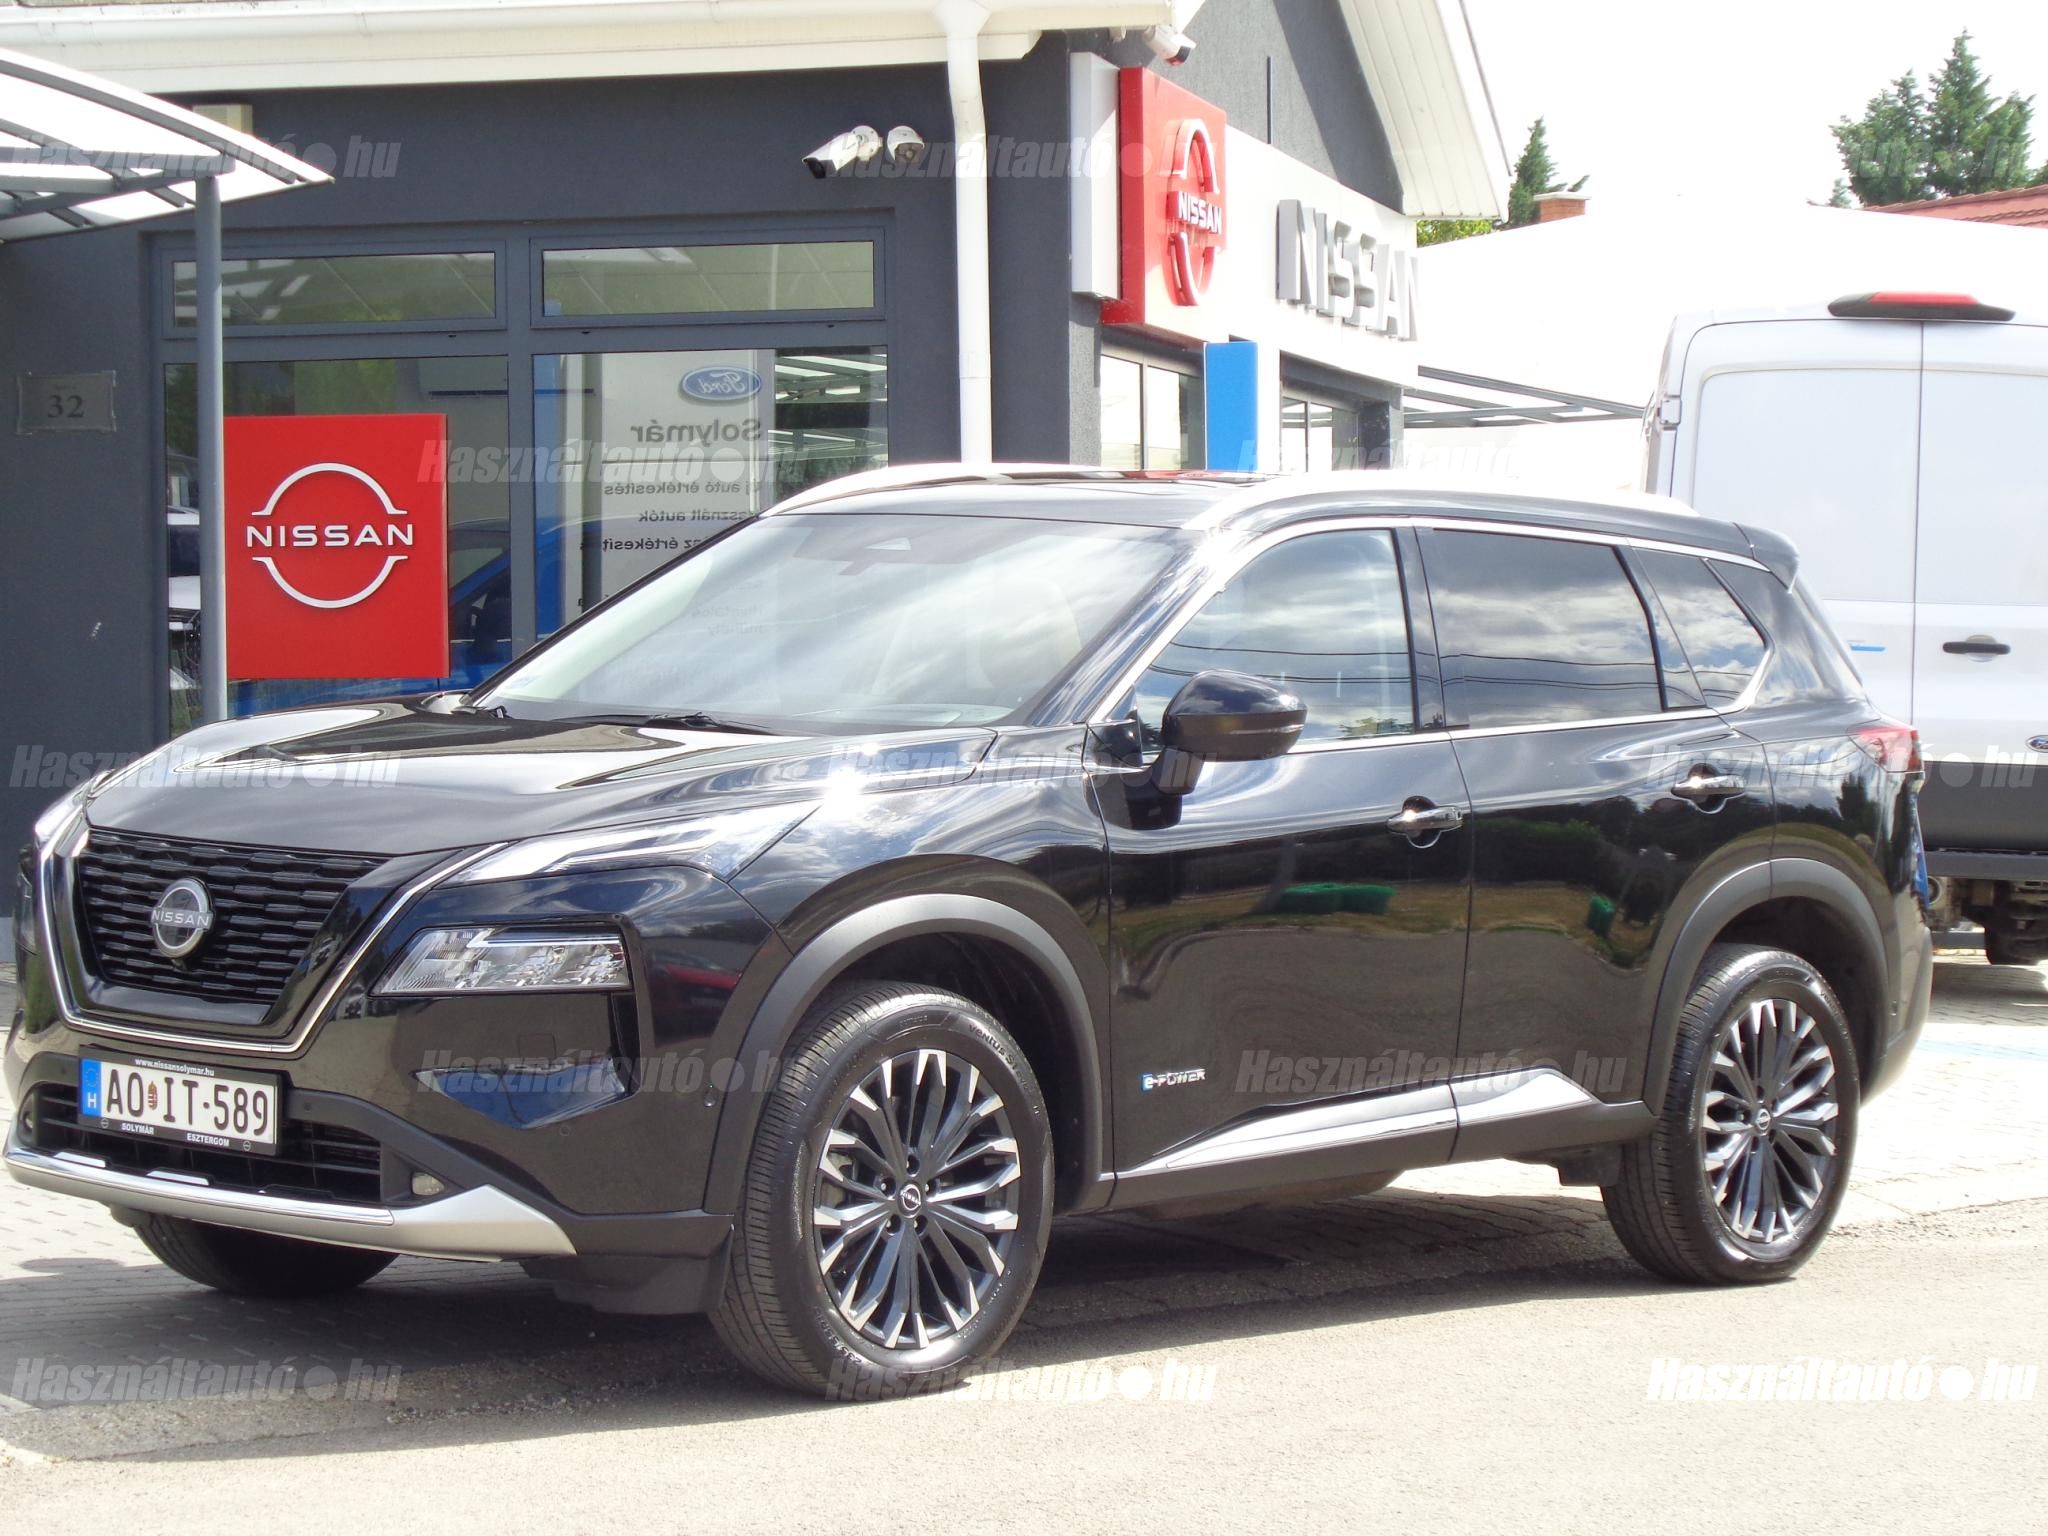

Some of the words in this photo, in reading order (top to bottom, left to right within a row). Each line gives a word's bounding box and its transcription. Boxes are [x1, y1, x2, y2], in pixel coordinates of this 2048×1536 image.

[1178, 190, 1222, 235] NISSAN
[1276, 198, 1419, 342] NISSAN
[47, 394, 85, 418] 32
[246, 524, 414, 548] NISSAN
[150, 909, 210, 927] NISSAN
[135, 1058, 215, 1077] www.nissansolymar.hu
[87, 1092, 97, 1109] H
[106, 1069, 144, 1117] AO
[187, 1132, 230, 1147] ESZTERGOM
